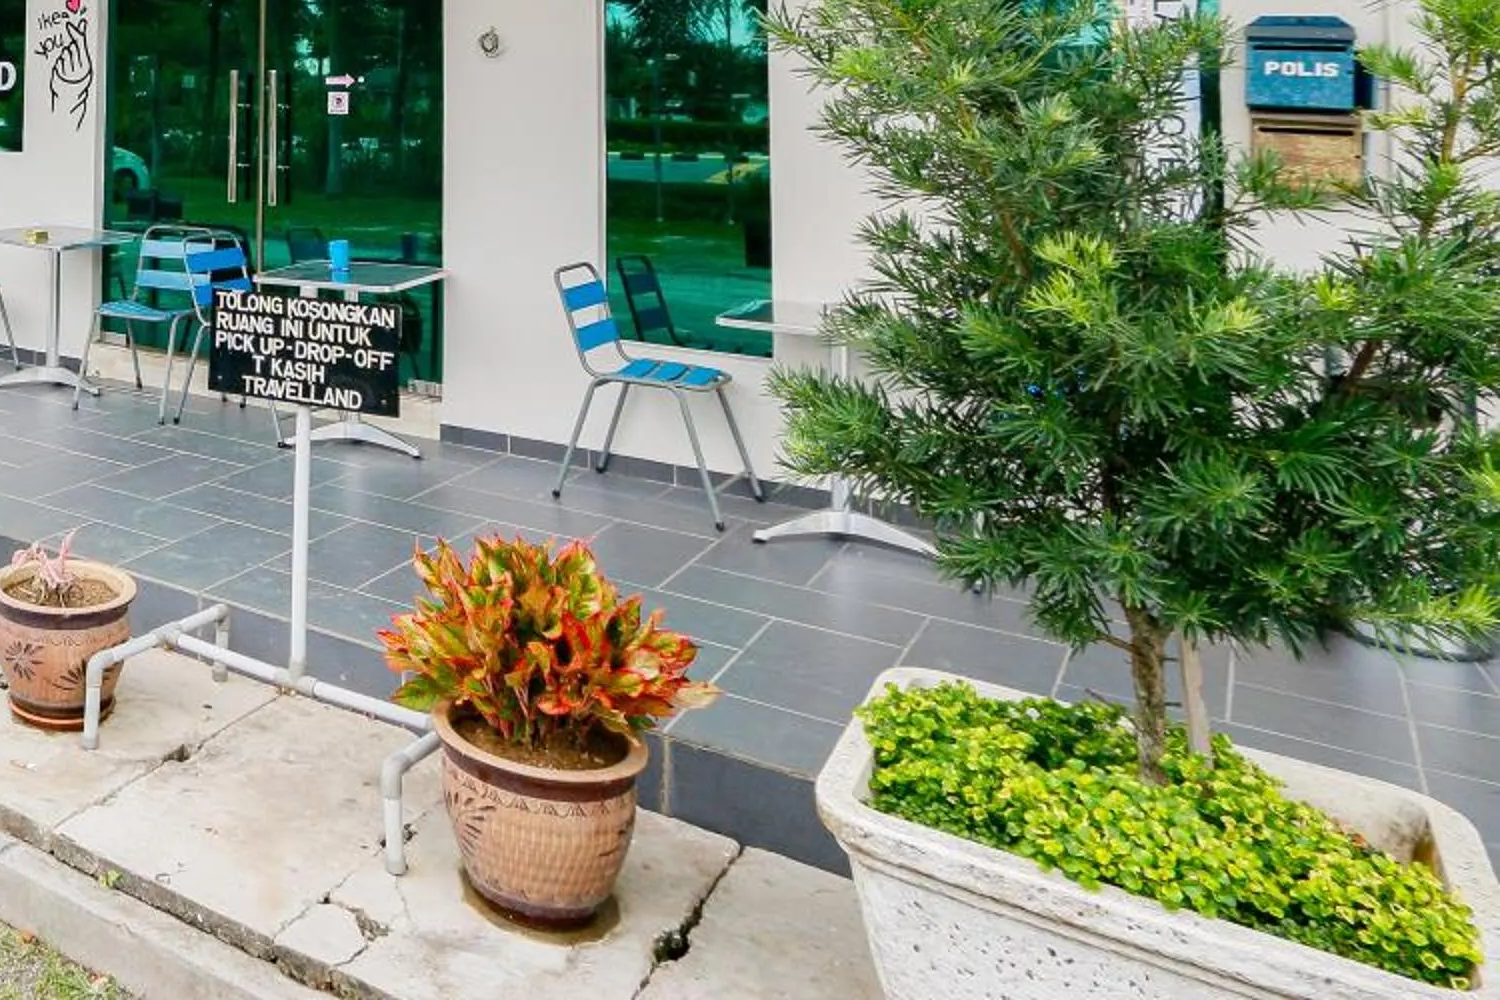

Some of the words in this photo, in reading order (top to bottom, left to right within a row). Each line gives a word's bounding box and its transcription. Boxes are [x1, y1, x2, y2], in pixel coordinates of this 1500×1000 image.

[1263, 61, 1340, 77] POLIS
[215, 291, 283, 315] TOLONG
[287, 298, 395, 328] KOSONGKAN
[215, 331, 254, 353] PICK
[216, 312, 274, 334] RUANG
[281, 319, 303, 338] INI
[309, 321, 372, 347] UNTUK
[252, 355, 265, 373] T
[271, 358, 324, 384] KASIH
[242, 376, 362, 409] TRAVELLAND
